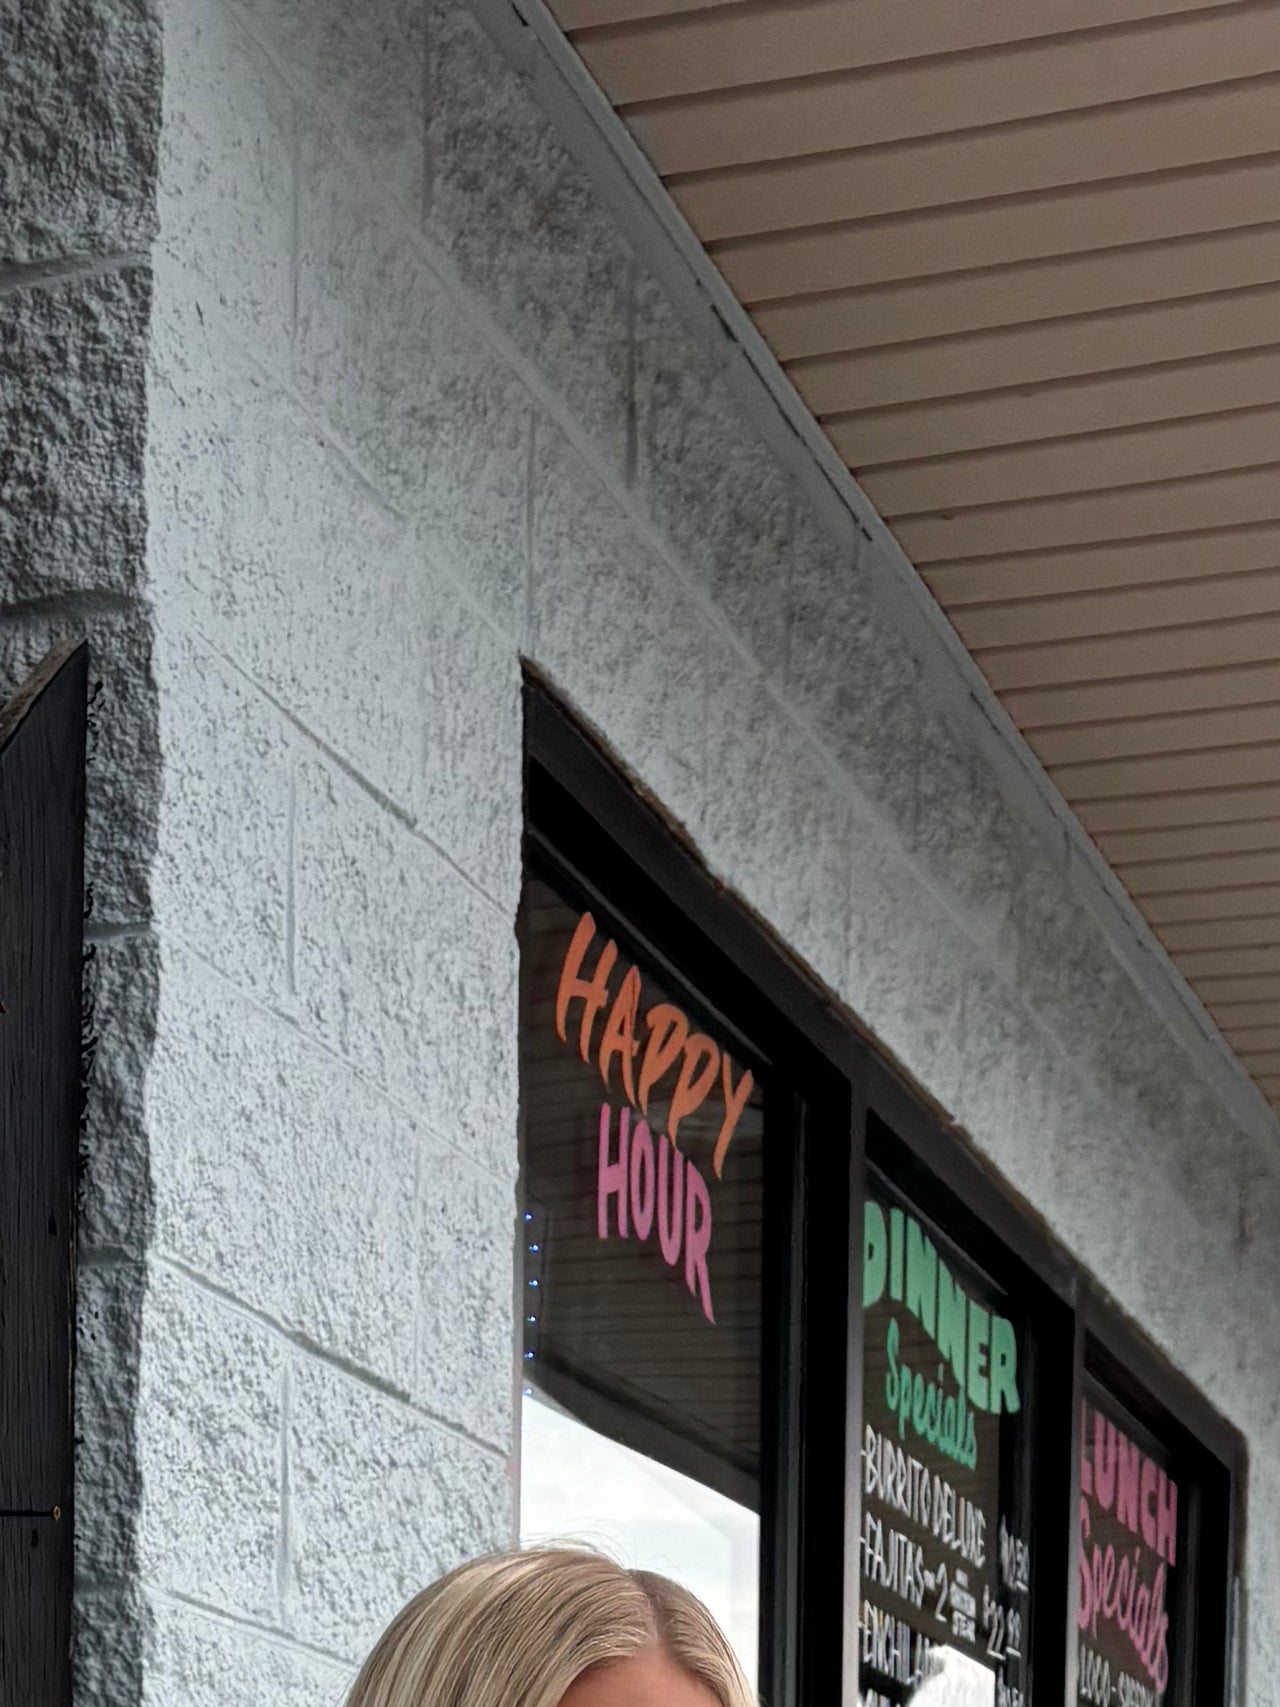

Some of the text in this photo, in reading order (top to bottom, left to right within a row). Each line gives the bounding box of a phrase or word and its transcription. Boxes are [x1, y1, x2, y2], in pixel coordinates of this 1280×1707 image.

[554, 910, 753, 1179] HAPPY
[596, 1102, 716, 1325] HOUR
[862, 1200, 1021, 1414] DINNER
[885, 1317, 978, 1471] Specials
[1080, 1396, 1178, 1568] LUNCH
